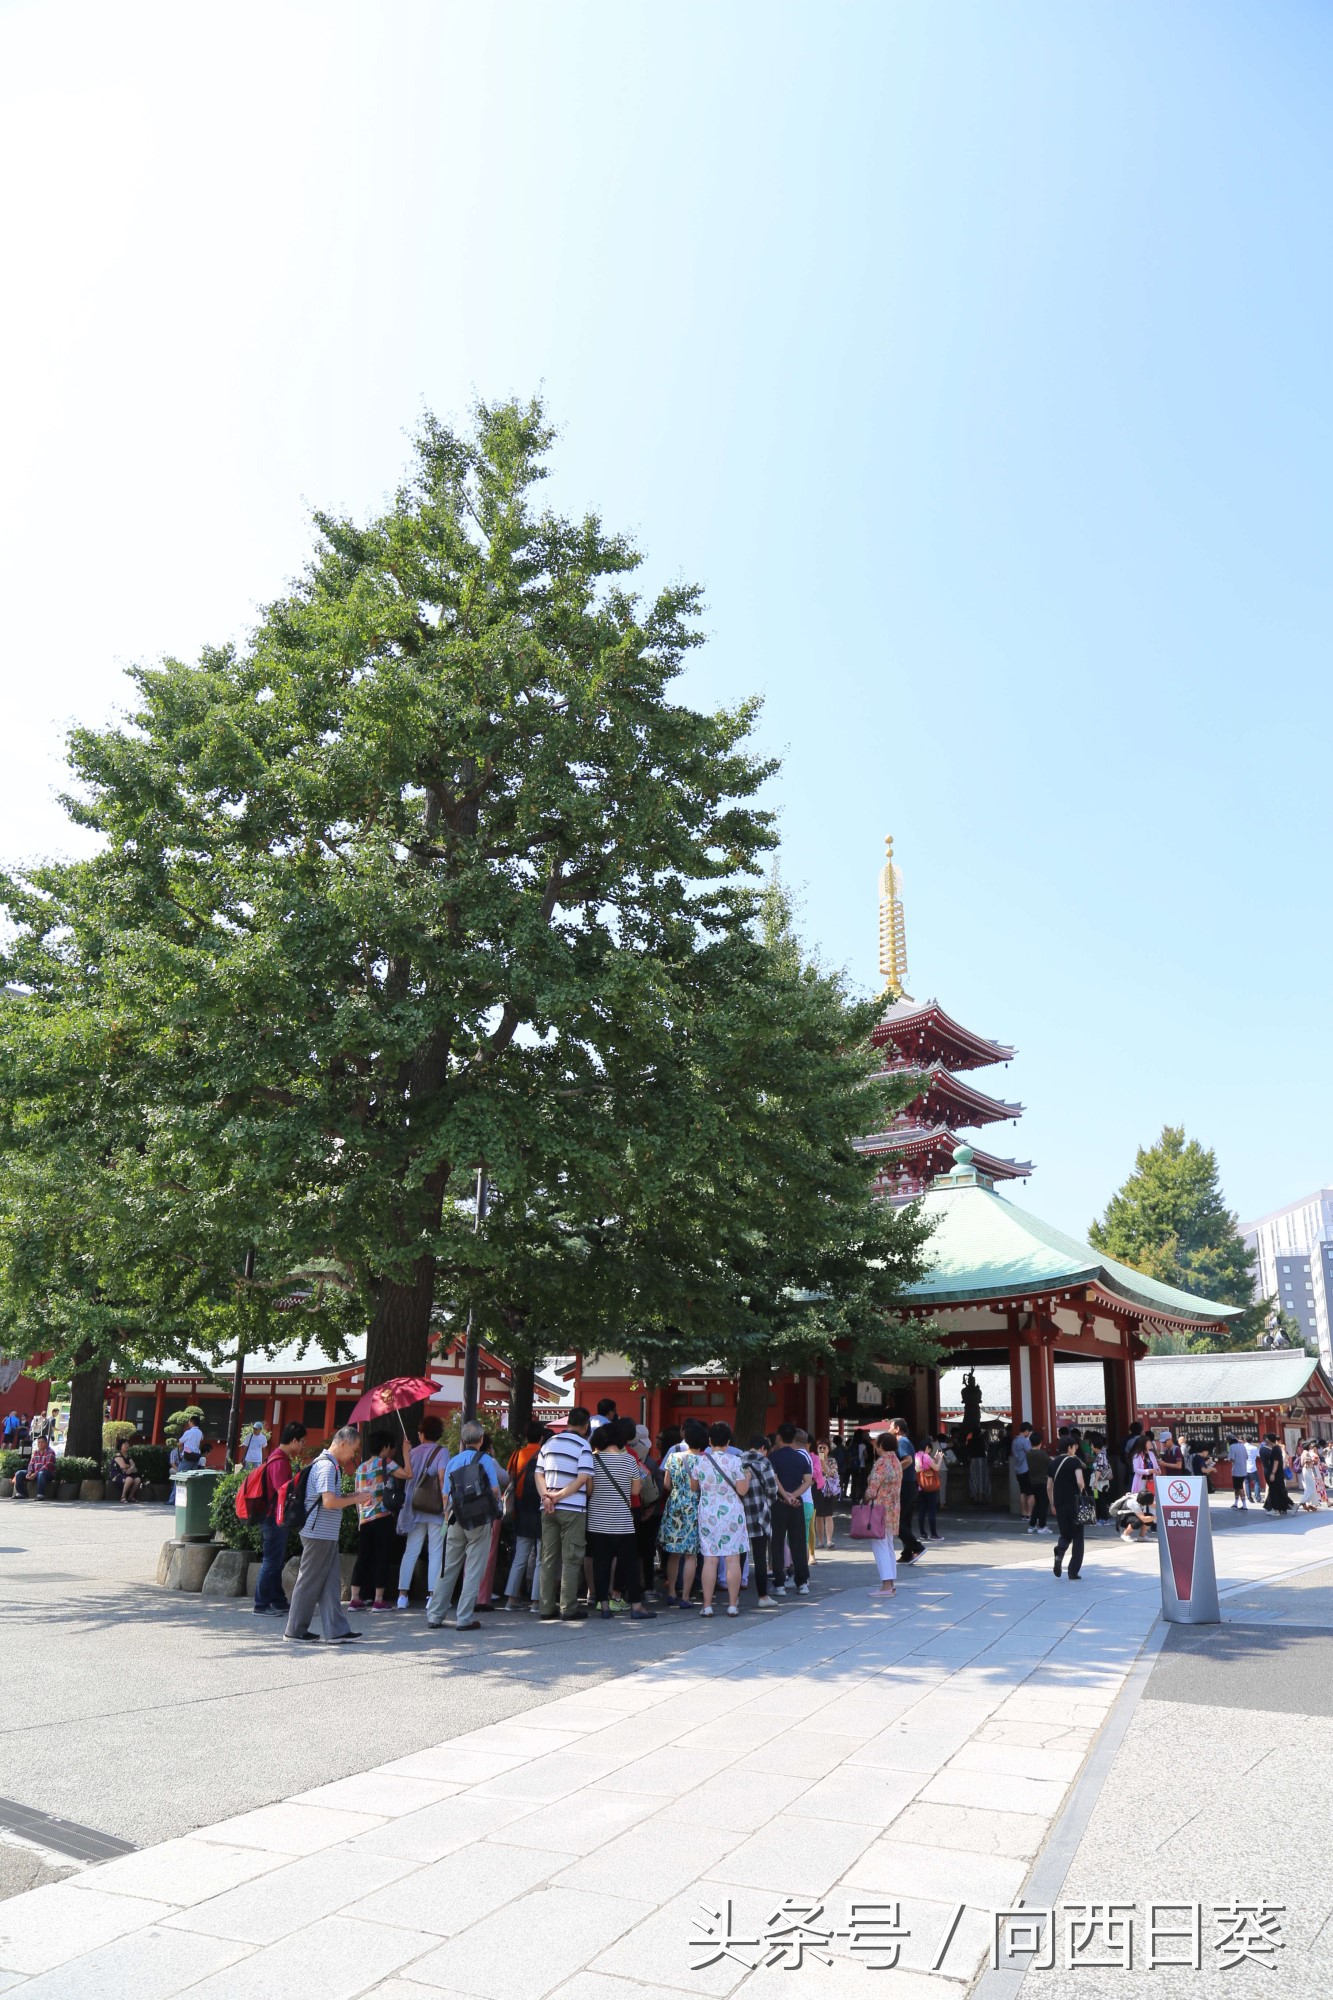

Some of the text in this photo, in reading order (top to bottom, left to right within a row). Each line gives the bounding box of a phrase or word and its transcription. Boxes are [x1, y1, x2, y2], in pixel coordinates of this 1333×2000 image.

[1170, 1511, 1190, 1519] 自転車
[1167, 1519, 1194, 1527] 進入禁止
